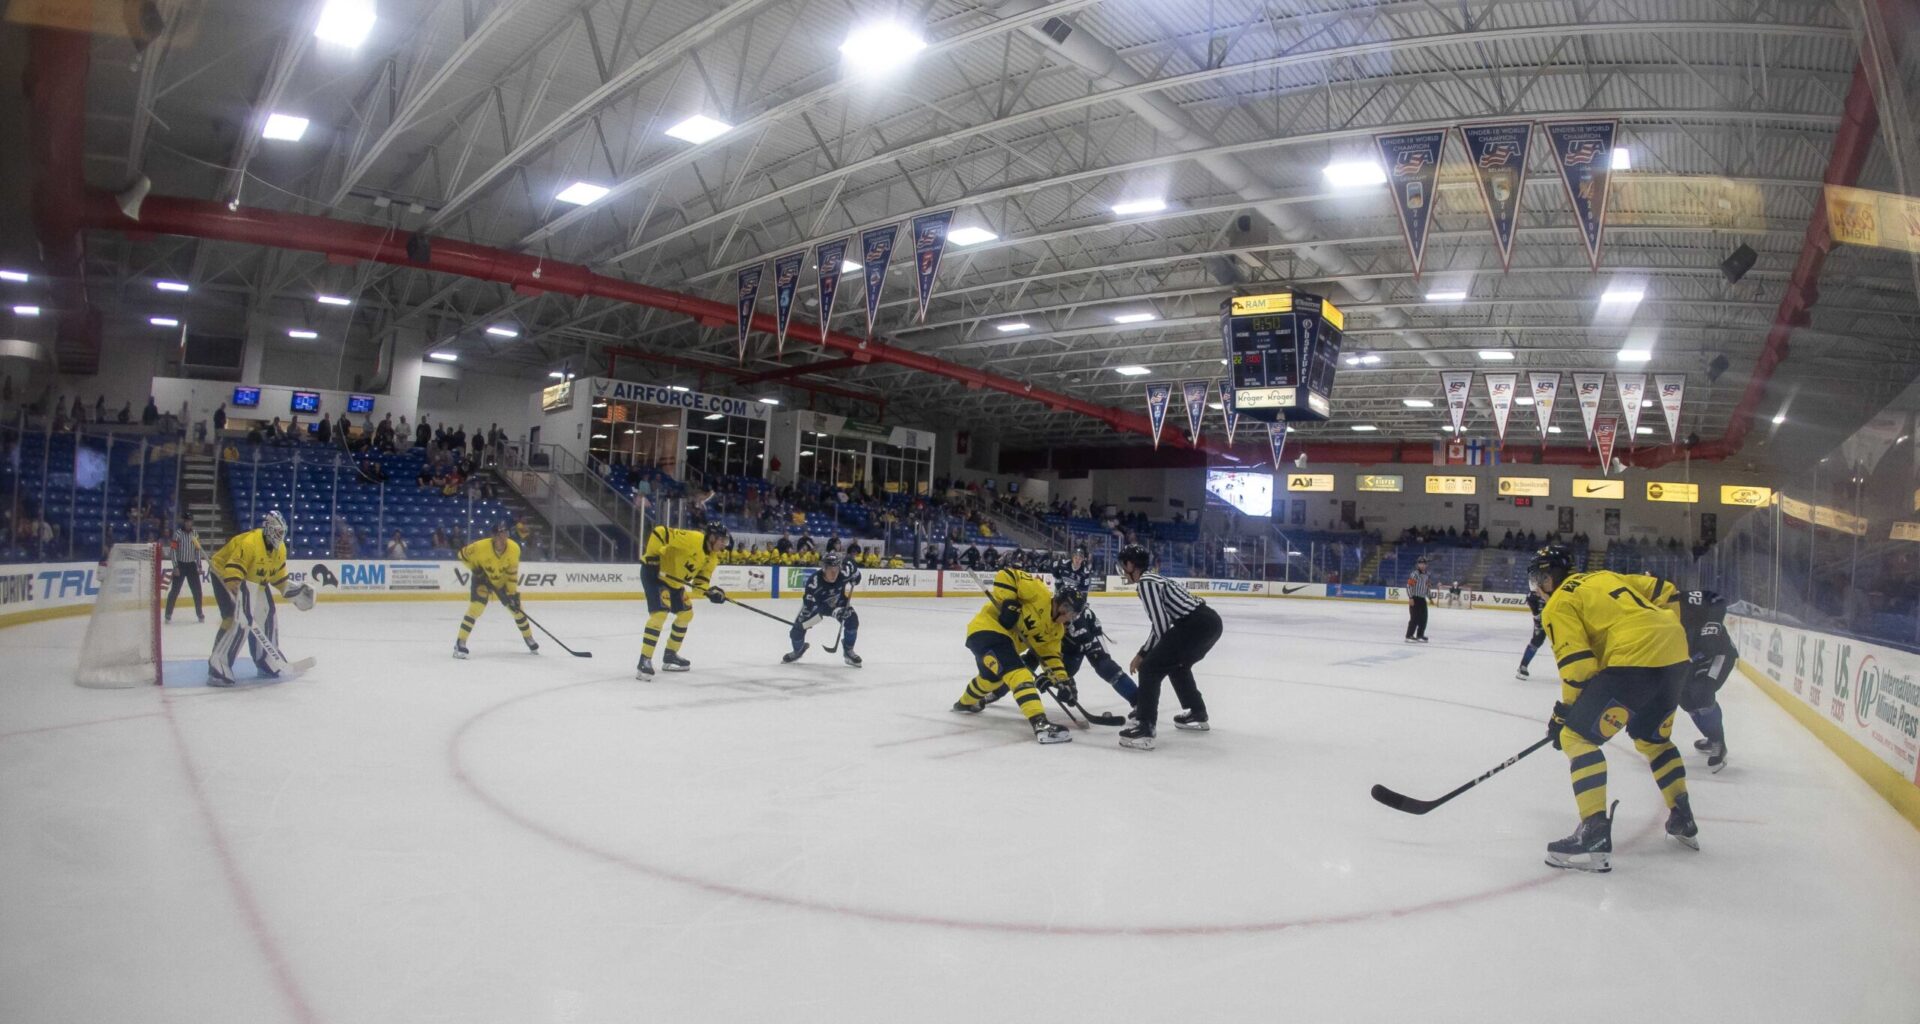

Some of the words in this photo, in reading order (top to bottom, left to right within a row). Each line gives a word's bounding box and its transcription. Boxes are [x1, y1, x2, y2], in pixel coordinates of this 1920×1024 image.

[1502, 126, 1526, 135] WORLD
[1585, 124, 1610, 133] WORLD
[1416, 133, 1440, 143] WORLD
[1478, 134, 1517, 143] CHAMPION
[1563, 132, 1601, 141] CHAMPION
[1393, 142, 1431, 151] CHAMPION
[1245, 299, 1266, 308] RAM
[612, 382, 748, 417] AIRFORCE.COM
[1238, 391, 1264, 406] Kroger
[1267, 390, 1294, 405] Kroger
[341, 564, 386, 585] RAM
[565, 572, 624, 584] WINMARK
[891, 574, 911, 587] Park
[1210, 581, 1250, 592] TRUE
[1608, 586, 1658, 612] 7
[1897, 703, 1919, 739] Press
